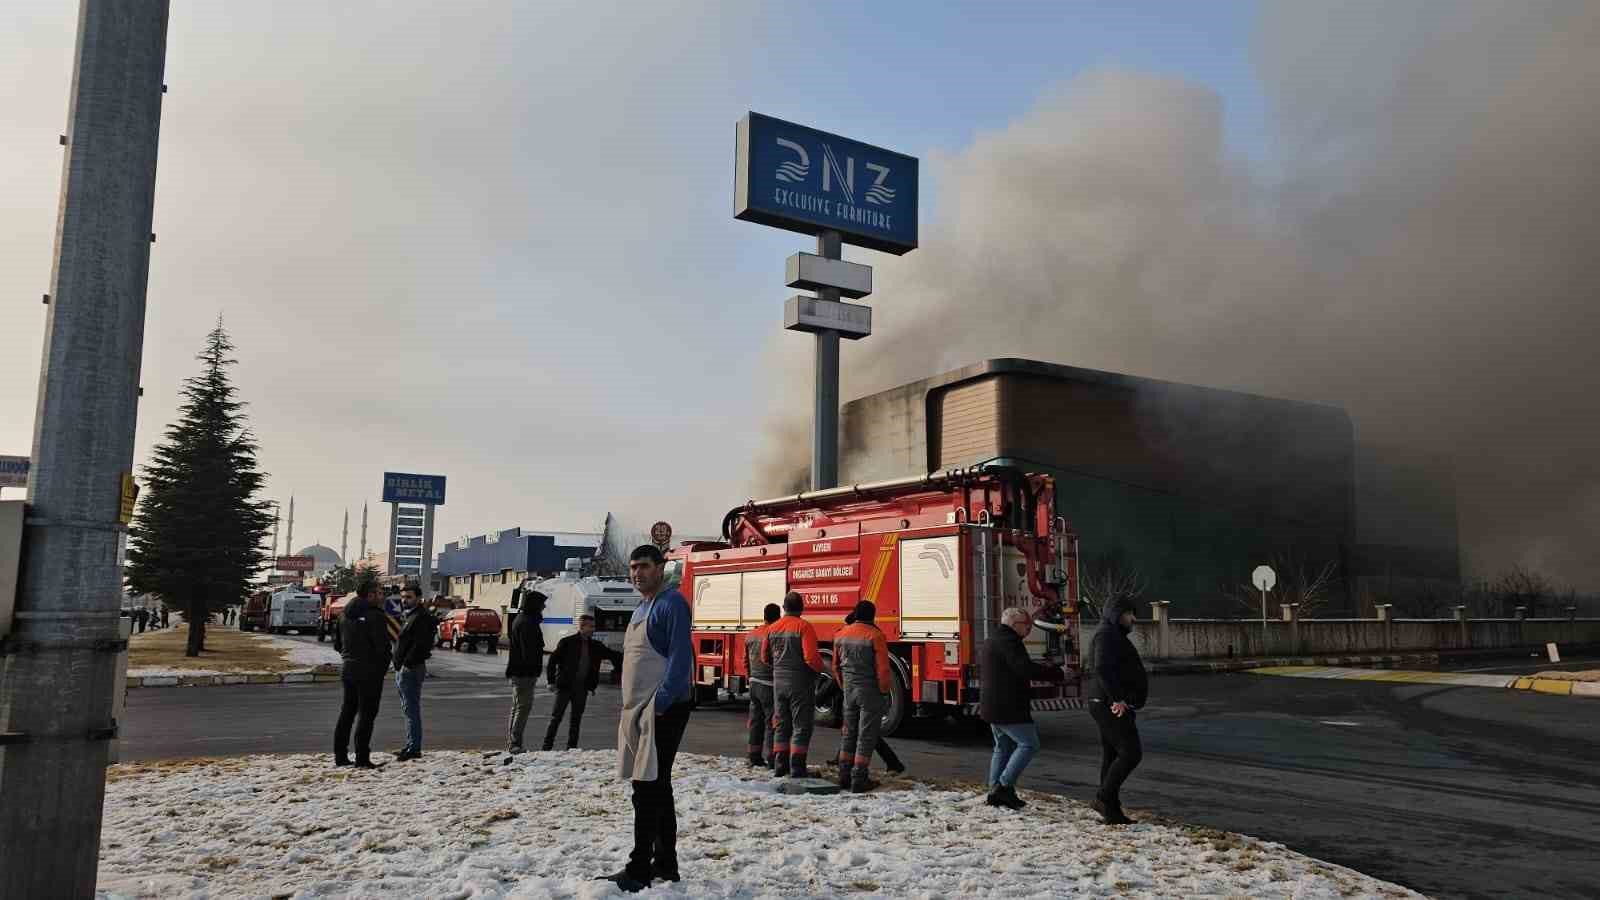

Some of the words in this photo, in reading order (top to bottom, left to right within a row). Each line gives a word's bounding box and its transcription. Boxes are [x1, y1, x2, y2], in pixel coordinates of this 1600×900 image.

[776, 137, 896, 206] DNZ
[775, 188, 830, 215] EXCLUSIVE
[837, 202, 892, 230] FURNITURE
[822, 594, 829, 605] 11
